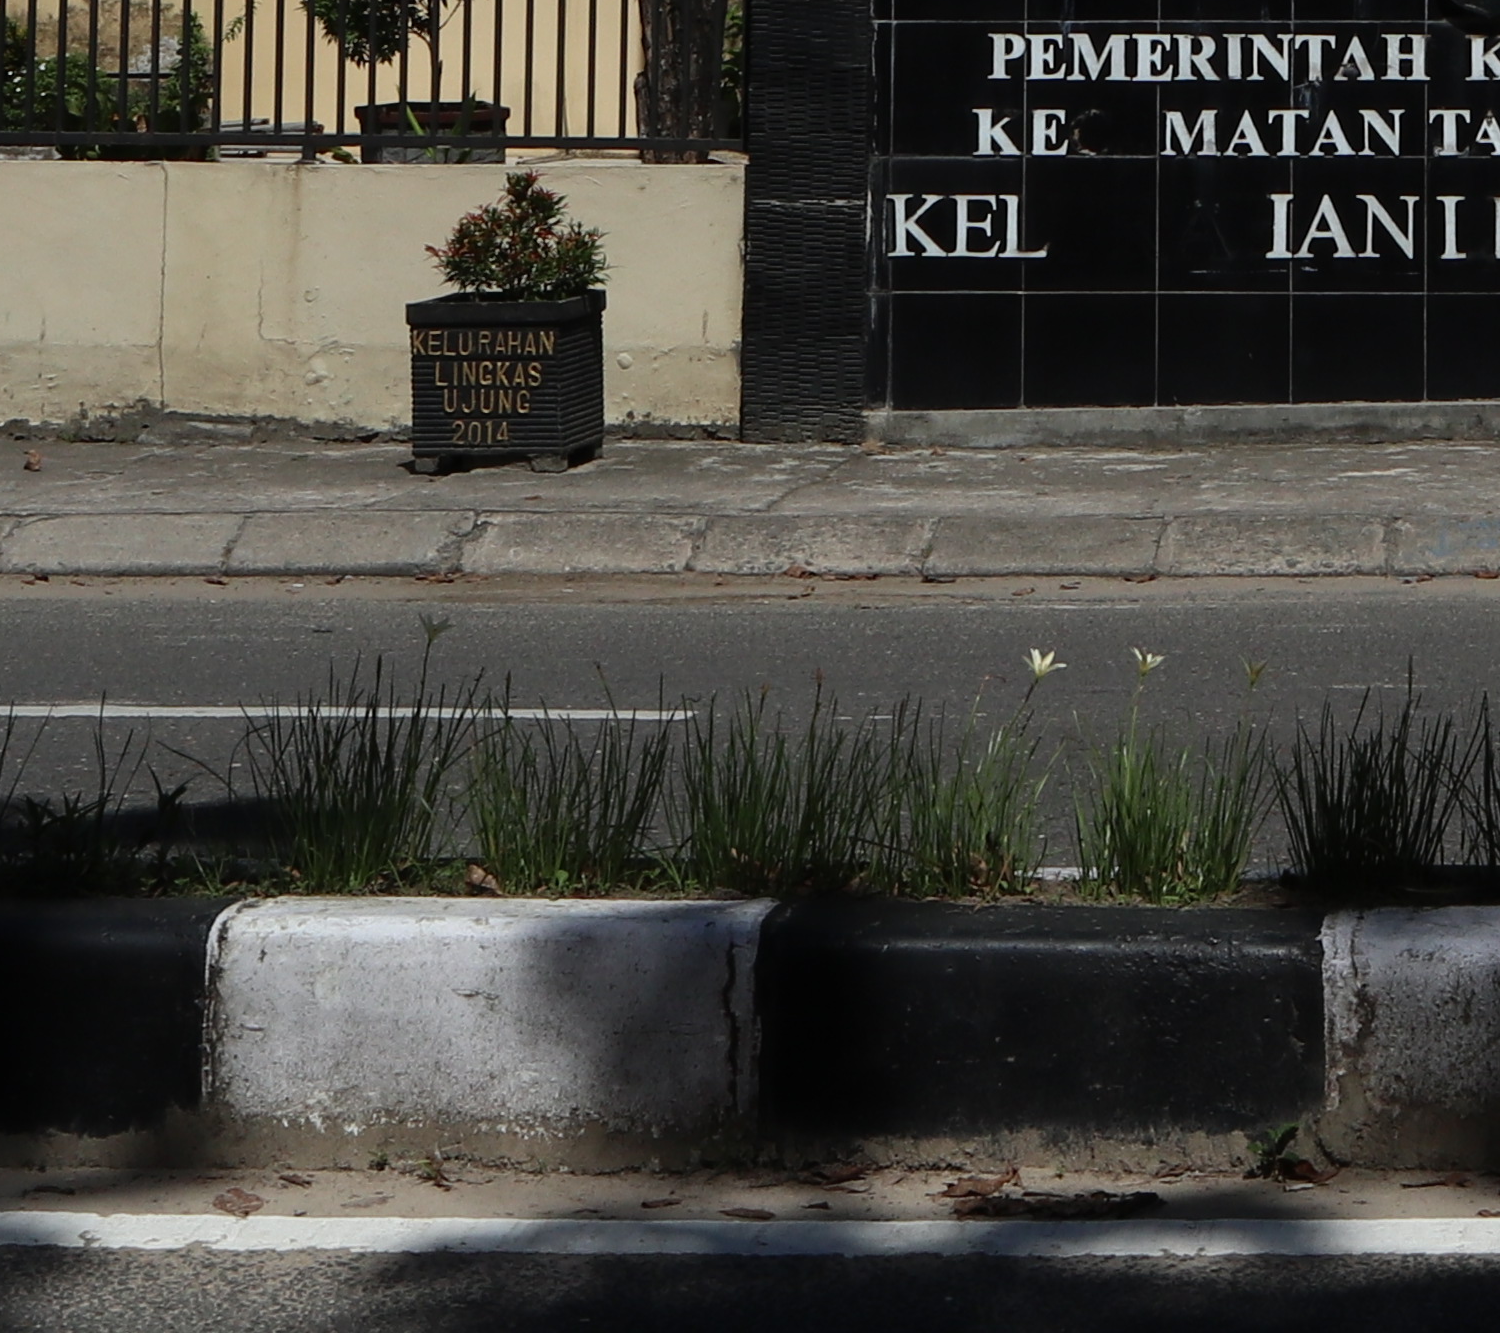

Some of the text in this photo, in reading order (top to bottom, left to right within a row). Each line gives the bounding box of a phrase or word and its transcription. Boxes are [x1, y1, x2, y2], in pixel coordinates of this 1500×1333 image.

[986, 33, 1431, 83] PEMERINTAH
[412, 330, 556, 356] KELURAHAN
[434, 362, 543, 387] LINGKAS
[443, 390, 532, 414] UJUNG
[451, 420, 510, 445] 2014
